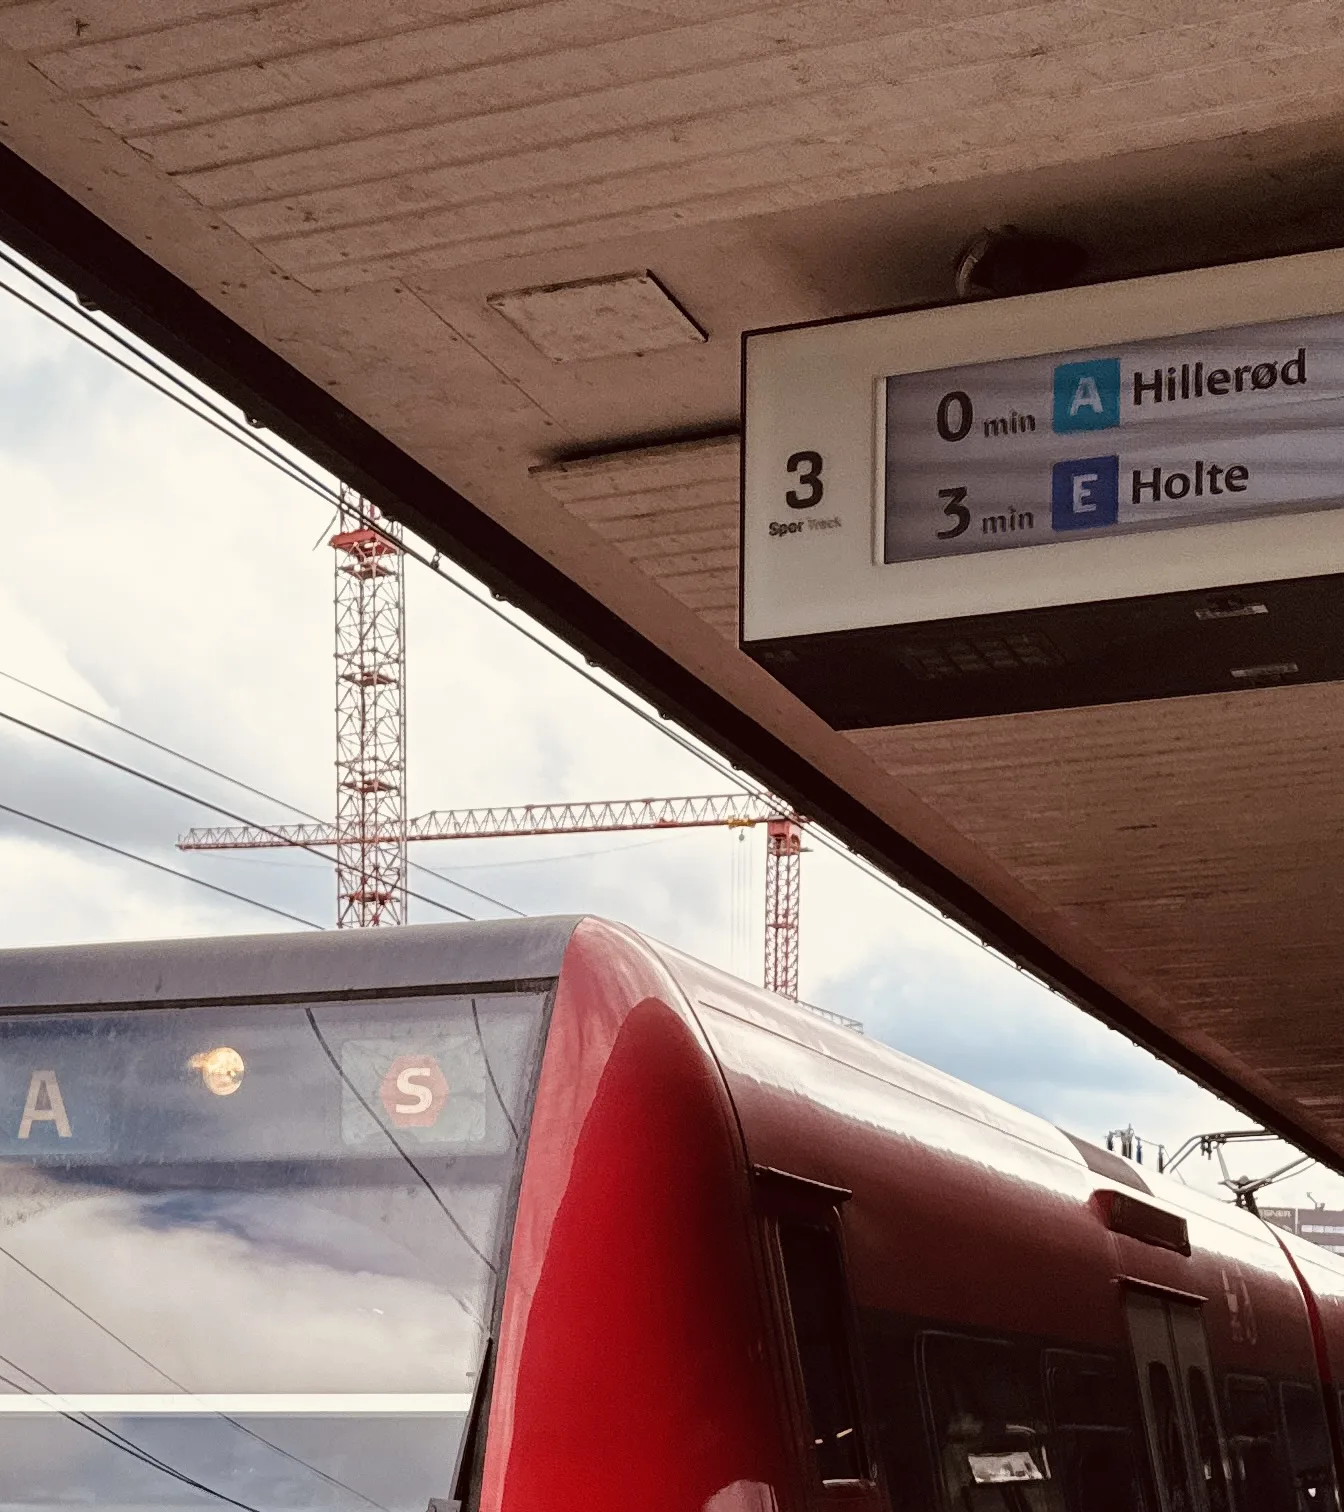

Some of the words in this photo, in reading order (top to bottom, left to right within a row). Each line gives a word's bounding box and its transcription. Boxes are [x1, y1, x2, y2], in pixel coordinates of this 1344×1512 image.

[936, 390, 974, 443] 0
[983, 408, 1037, 438] min
[1069, 375, 1105, 417] A
[1132, 347, 1308, 406] Hillerød
[785, 450, 824, 510] 3
[936, 485, 972, 540] 3
[981, 505, 1035, 535] min
[1071, 472, 1099, 514] E
[1131, 460, 1250, 505] Holte
[768, 520, 805, 538] Spor
[17, 1069, 74, 1140] A
[393, 1066, 433, 1115] S
